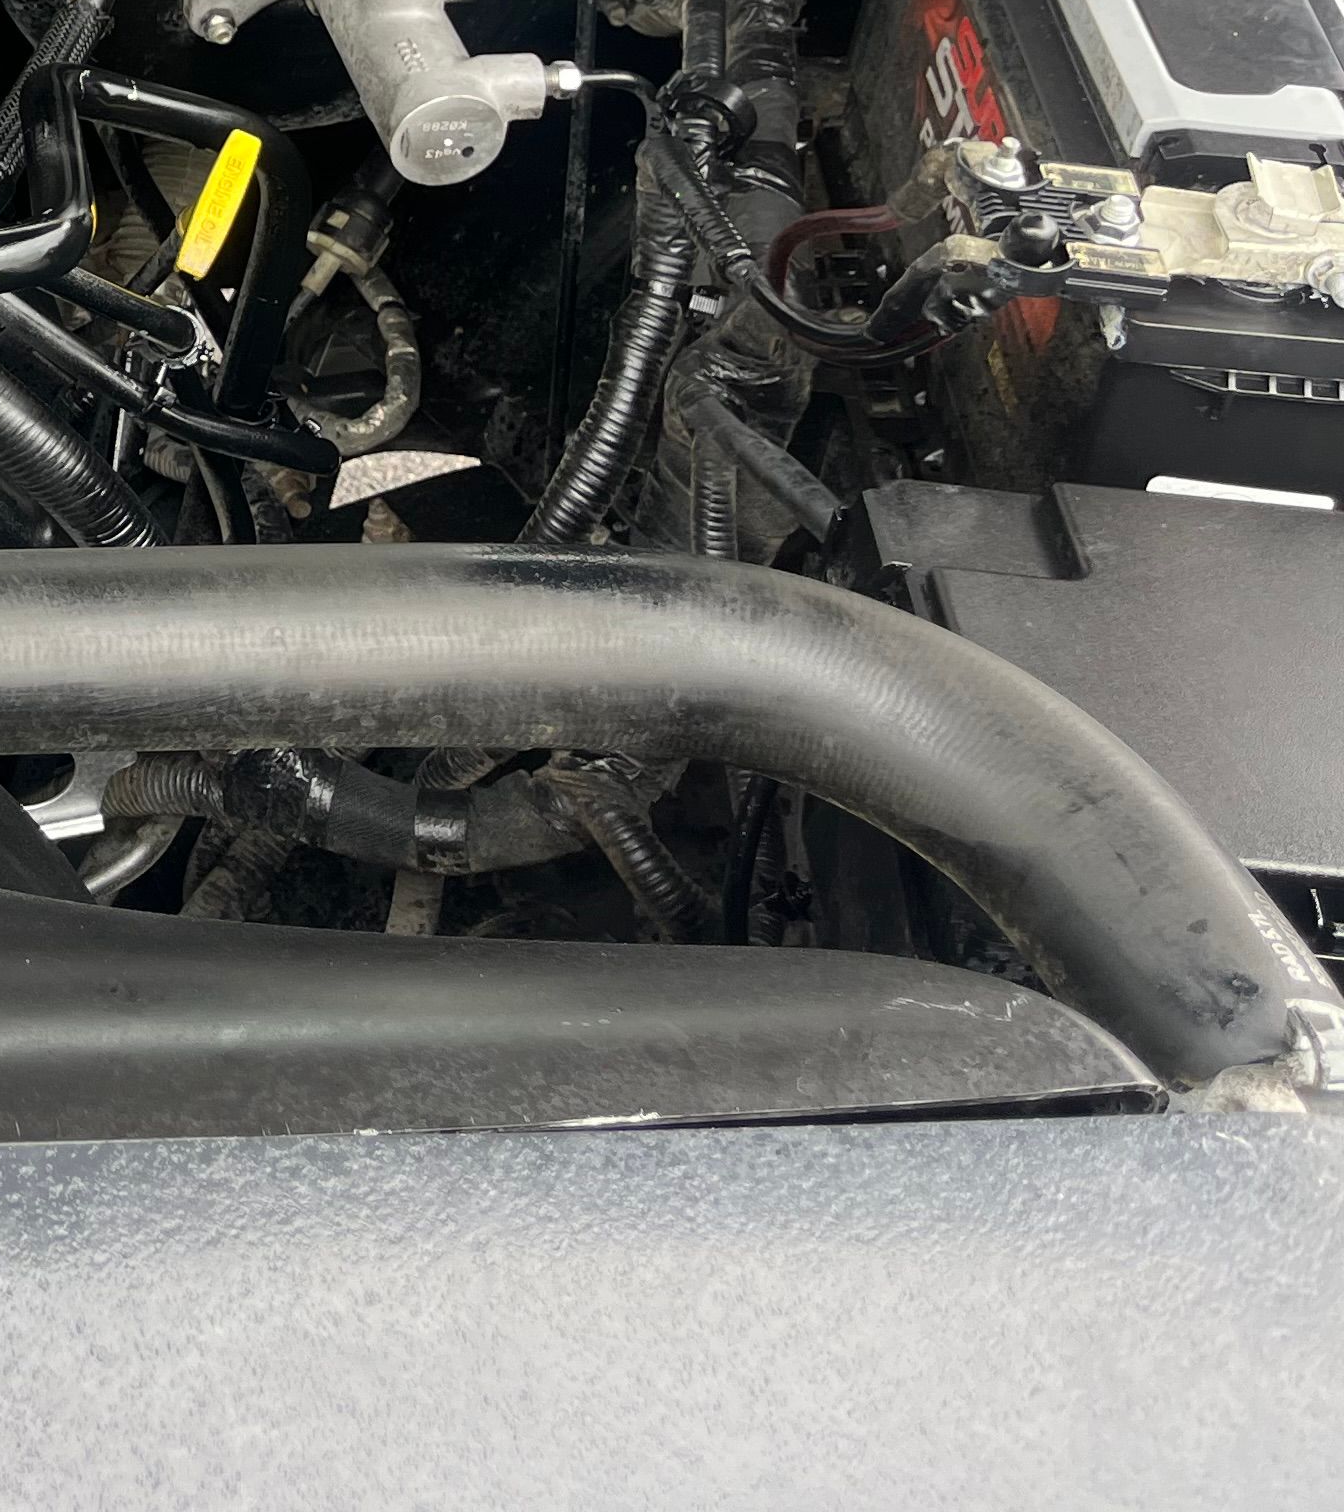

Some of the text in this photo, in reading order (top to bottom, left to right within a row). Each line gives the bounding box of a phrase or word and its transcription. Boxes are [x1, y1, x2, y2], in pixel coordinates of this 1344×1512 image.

[194, 155, 243, 245] ENGINE OIL
[1271, 942, 1311, 983] RAD
